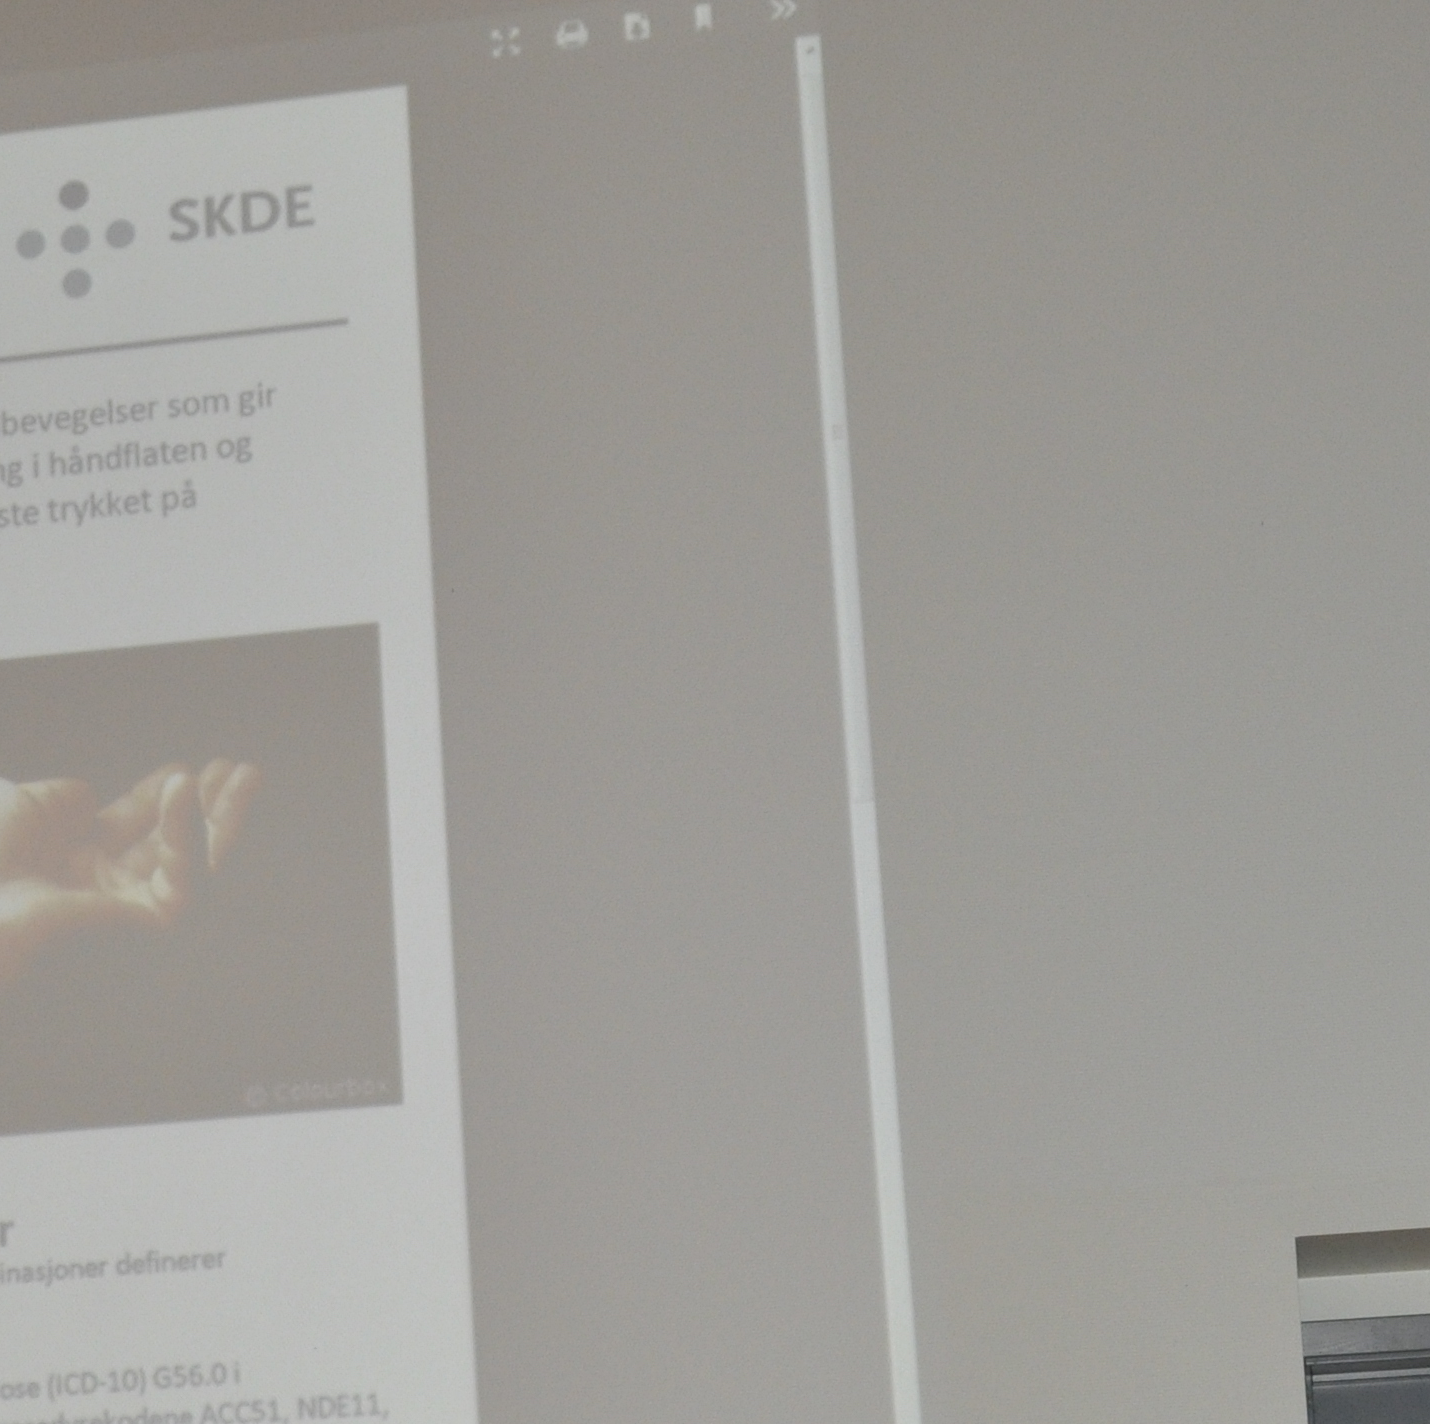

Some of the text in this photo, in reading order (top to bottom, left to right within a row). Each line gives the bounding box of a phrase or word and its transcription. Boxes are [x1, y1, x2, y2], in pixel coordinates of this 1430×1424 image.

[168, 183, 315, 244] SKDE
[167, 392, 231, 420] som
[236, 381, 277, 419] gir
[47, 440, 209, 478] håndflaten
[214, 434, 254, 466] og
[46, 488, 153, 528] trykket
[159, 478, 198, 519] på
[113, 1248, 227, 1278] definerer
[45, 1366, 148, 1403] (ICD-10)
[150, 1361, 229, 1391] G56.0
[295, 1391, 390, 1421] NDE11,
